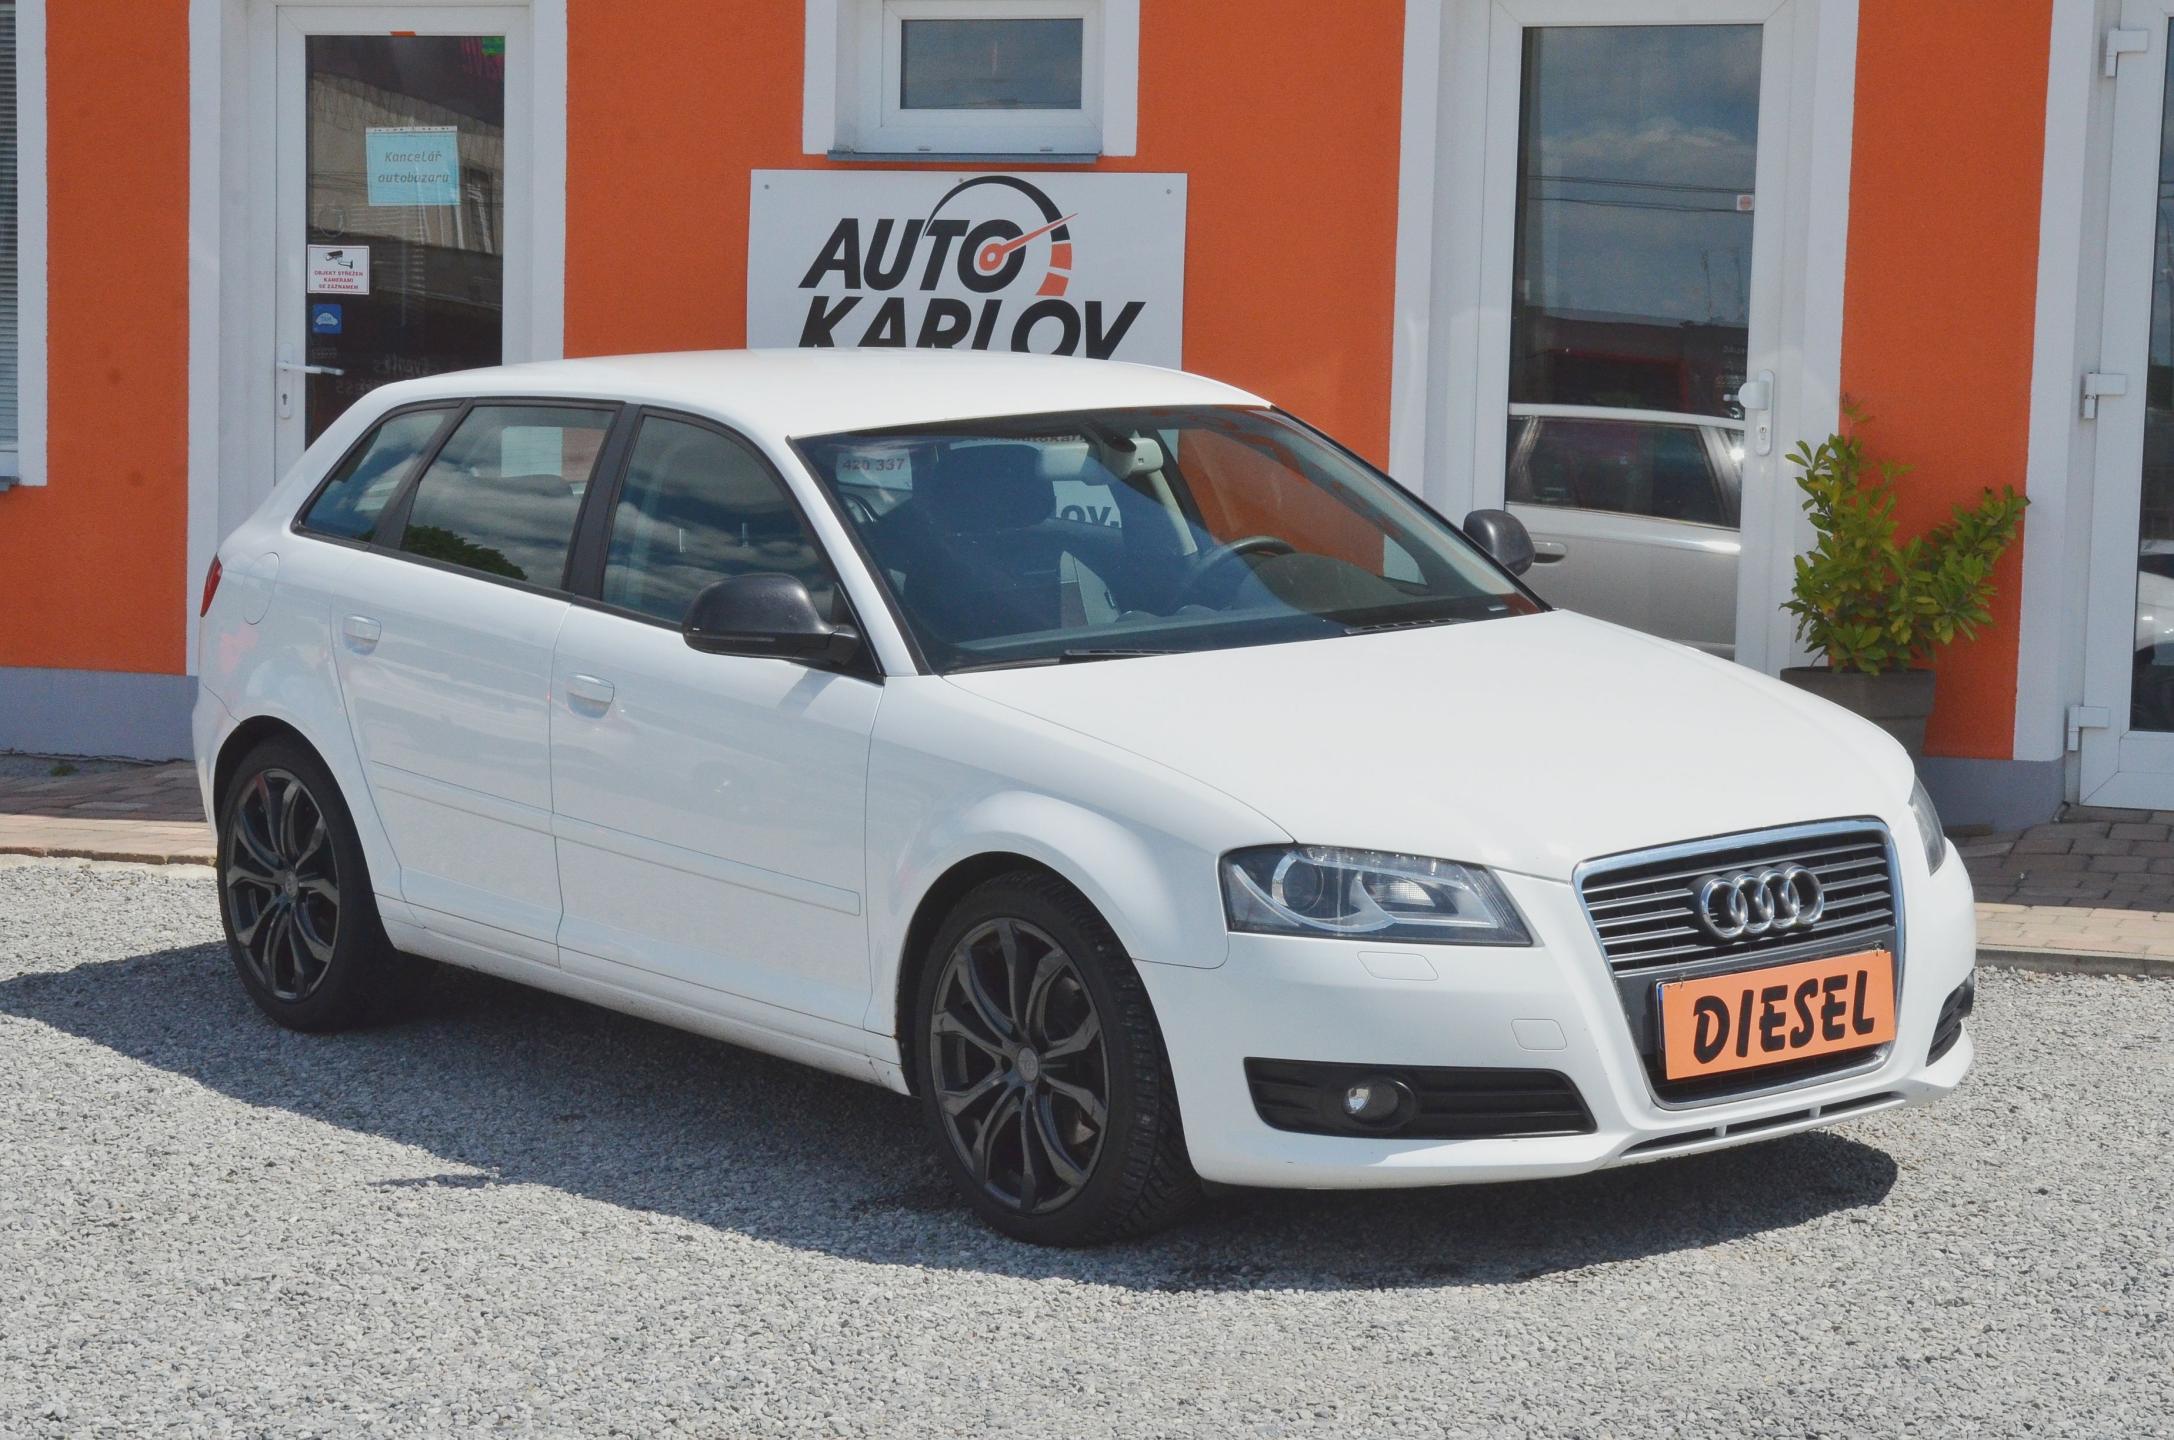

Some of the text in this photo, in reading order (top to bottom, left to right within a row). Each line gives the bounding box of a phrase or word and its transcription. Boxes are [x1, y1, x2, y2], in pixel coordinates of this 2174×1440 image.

[384, 150, 443, 162] Kancelář
[377, 171, 450, 184] autobazaru
[798, 217, 1028, 294] AUTO
[875, 458, 905, 471] 337
[1692, 969, 1876, 1065] DIESEL
